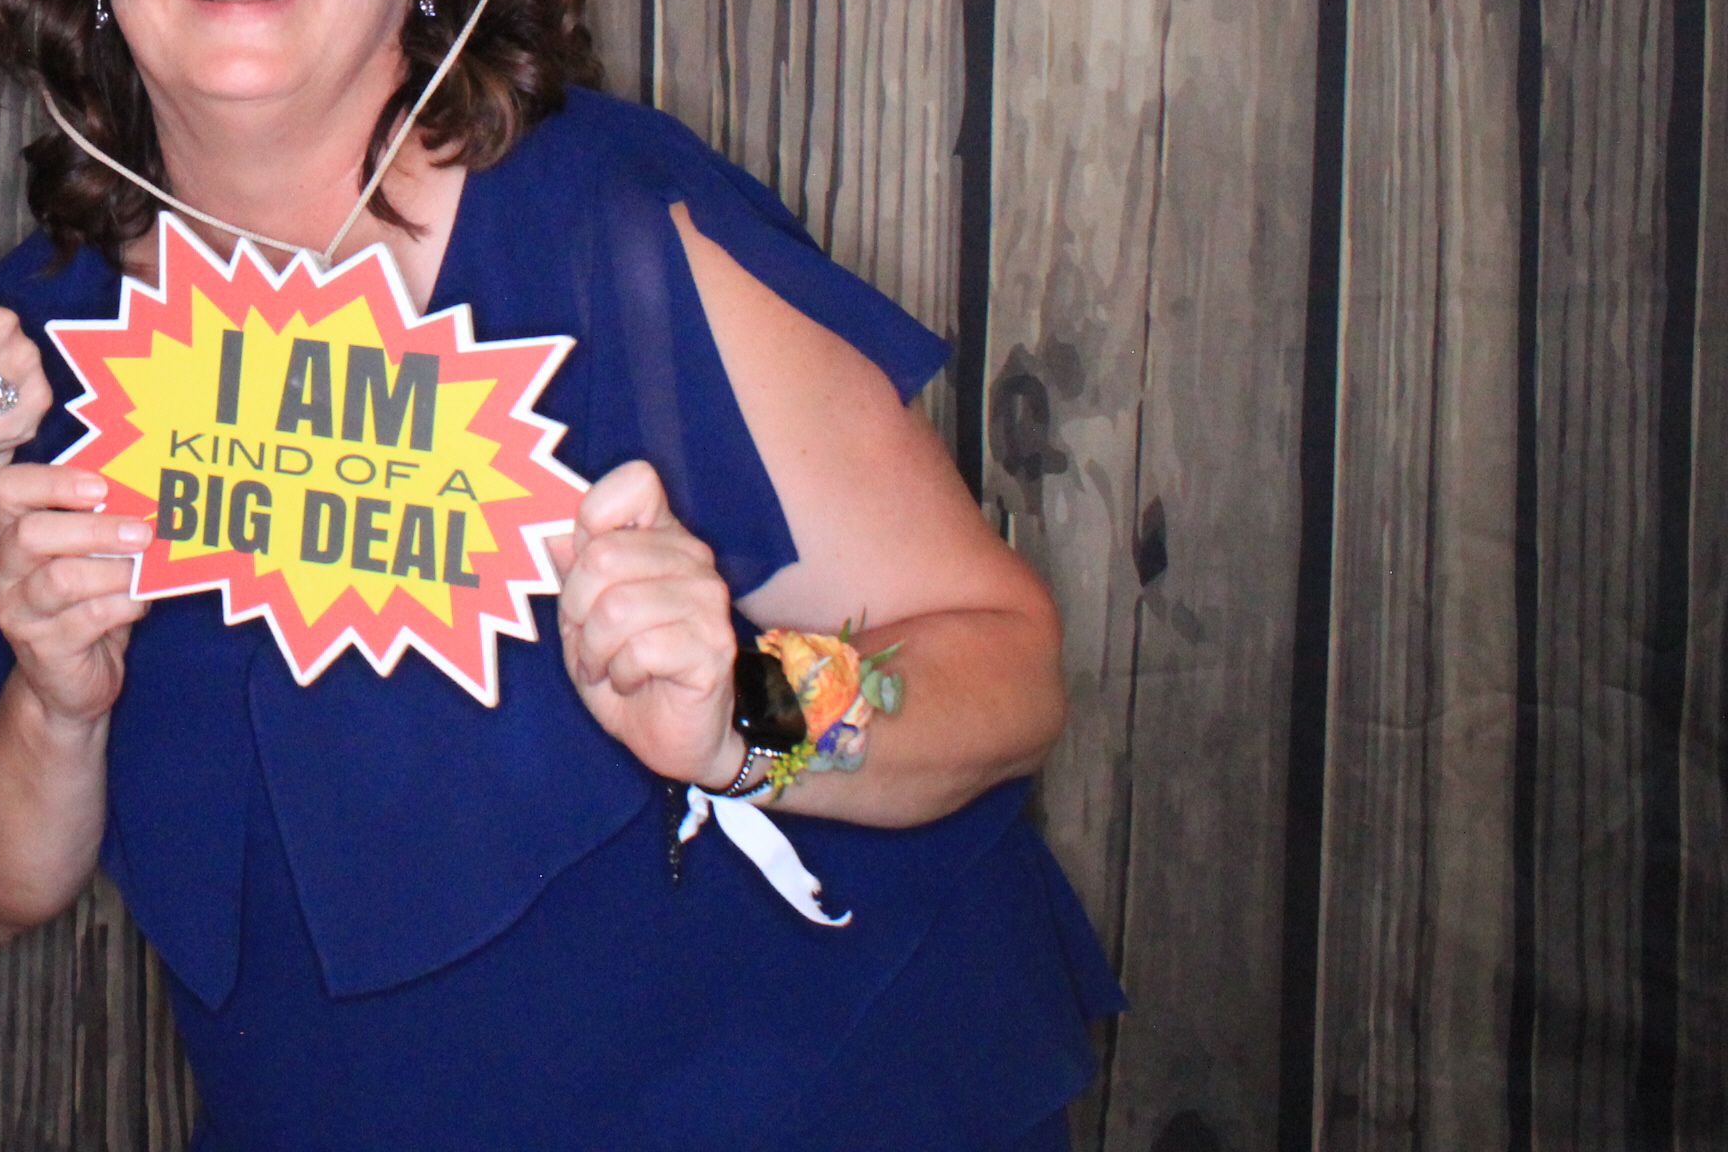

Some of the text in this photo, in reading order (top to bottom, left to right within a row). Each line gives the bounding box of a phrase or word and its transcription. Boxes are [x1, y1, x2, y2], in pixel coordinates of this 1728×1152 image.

[215, 329, 440, 452] I AM
[168, 430, 478, 501] KIND OF A
[155, 467, 481, 589] BIG DEAL
